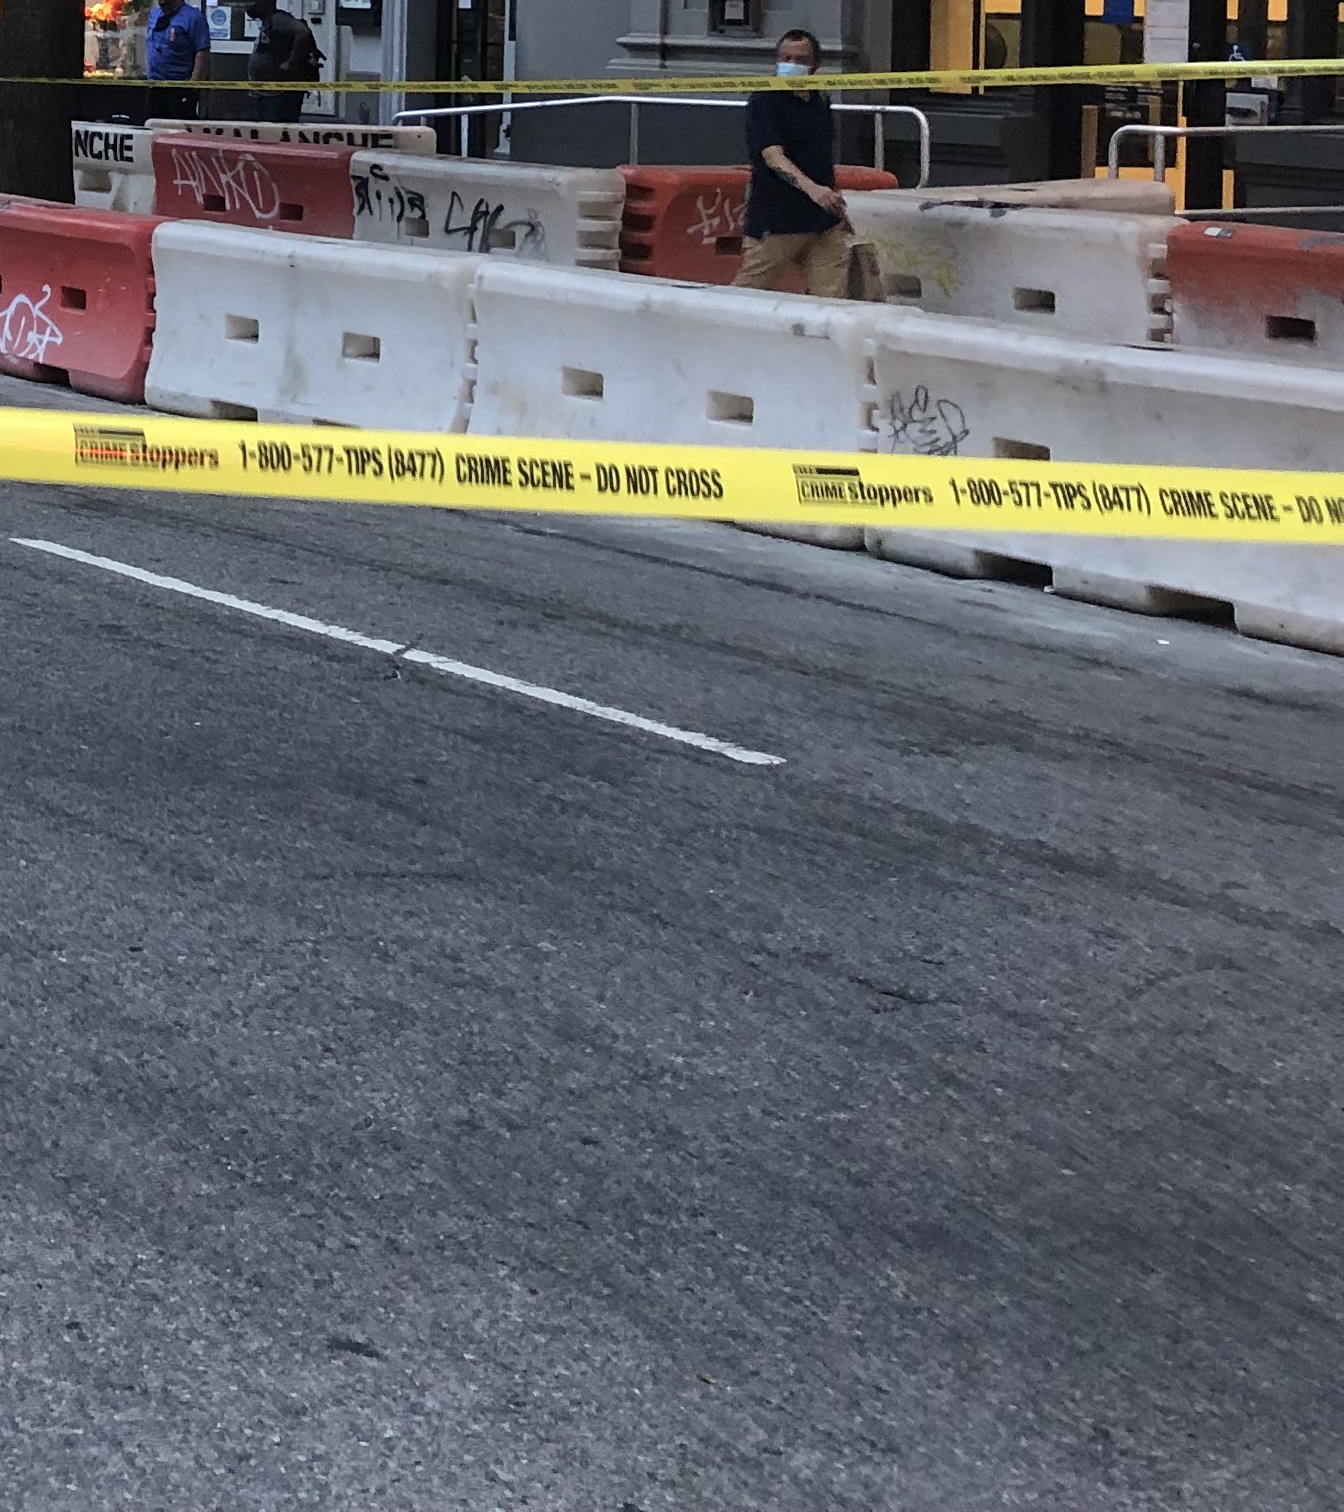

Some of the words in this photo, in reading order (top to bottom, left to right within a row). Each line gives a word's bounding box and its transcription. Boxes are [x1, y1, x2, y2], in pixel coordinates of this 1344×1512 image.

[238, 438, 384, 478] 1-800-577-TIPS
[388, 444, 445, 484] (8477)
[456, 452, 512, 488] CRIME
[517, 456, 575, 491] SCENE
[595, 462, 621, 494] DO
[626, 463, 659, 497] NOT
[665, 466, 724, 501] CROSS
[949, 476, 1090, 511] 1-800-577-TIPS
[1094, 480, 1151, 517] (8477)
[1159, 487, 1217, 519] CRIME
[1224, 491, 1280, 522] SCENE
[1295, 494, 1324, 525] DO
